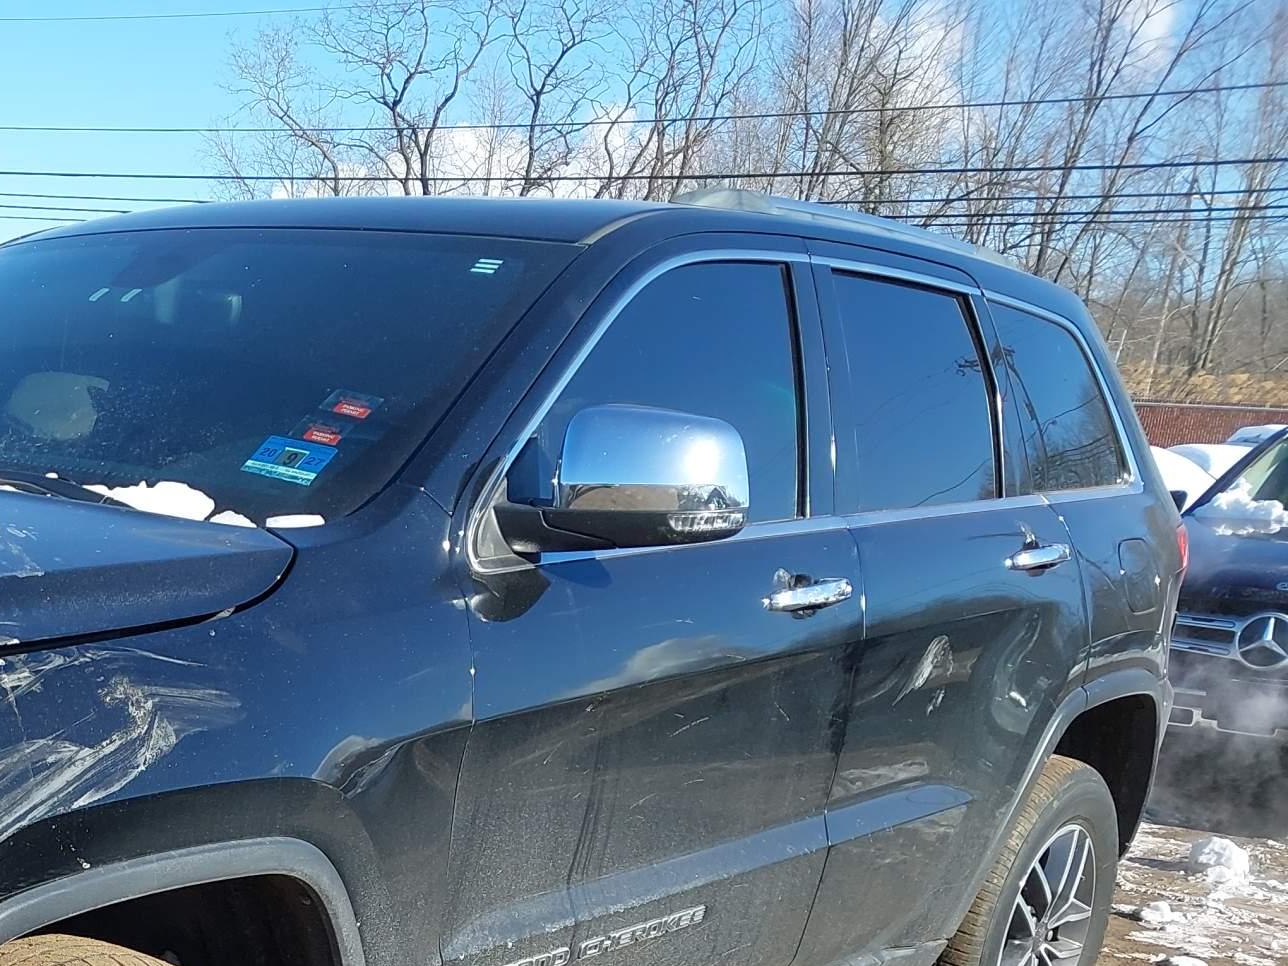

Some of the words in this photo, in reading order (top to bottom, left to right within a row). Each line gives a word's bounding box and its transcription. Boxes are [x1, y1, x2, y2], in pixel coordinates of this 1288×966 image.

[259, 447, 276, 458] 20
[283, 452, 298, 465] 9
[304, 456, 322, 466] 27
[578, 905, 708, 960] CHEROKEE
